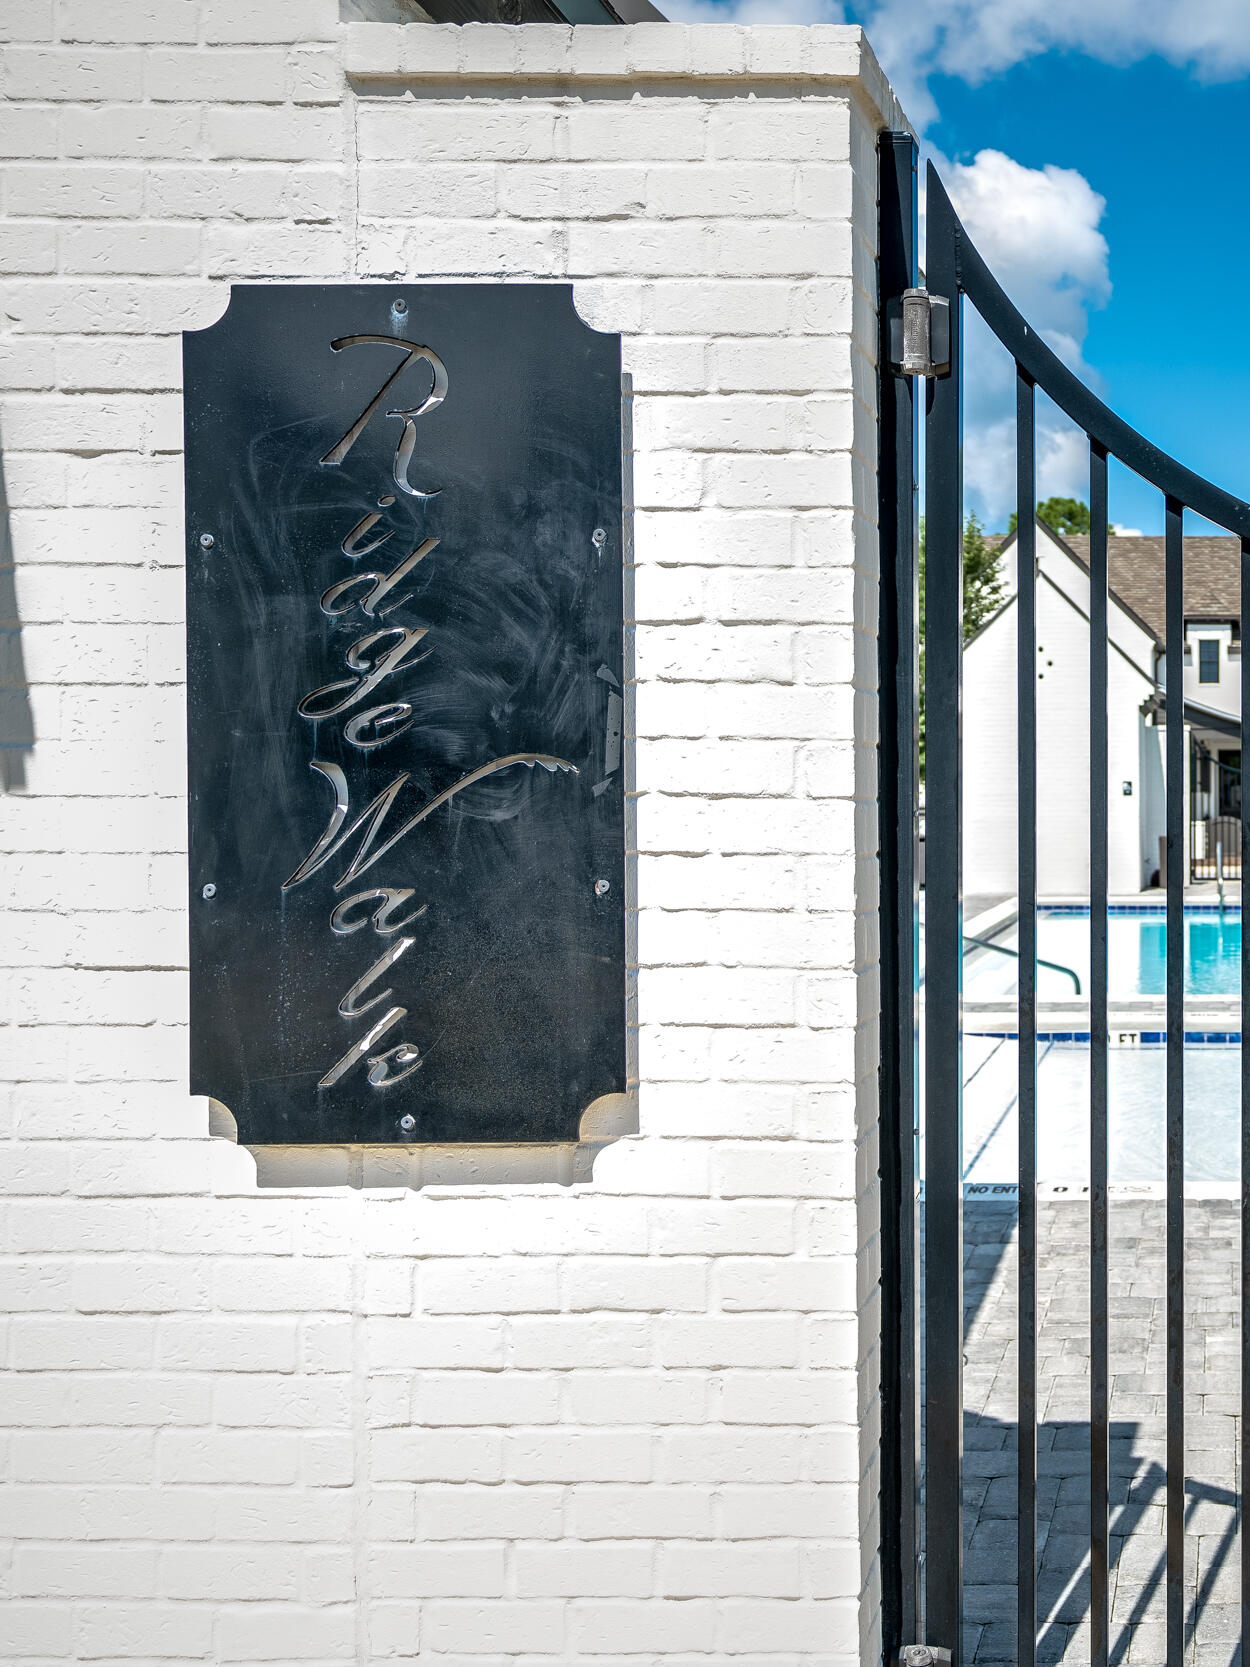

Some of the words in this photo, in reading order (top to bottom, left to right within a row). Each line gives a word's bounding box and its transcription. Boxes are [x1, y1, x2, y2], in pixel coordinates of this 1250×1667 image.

[298, 333, 449, 747] Ridge
[282, 752, 580, 1087] Walk
[967, 1186, 988, 1194] NO
